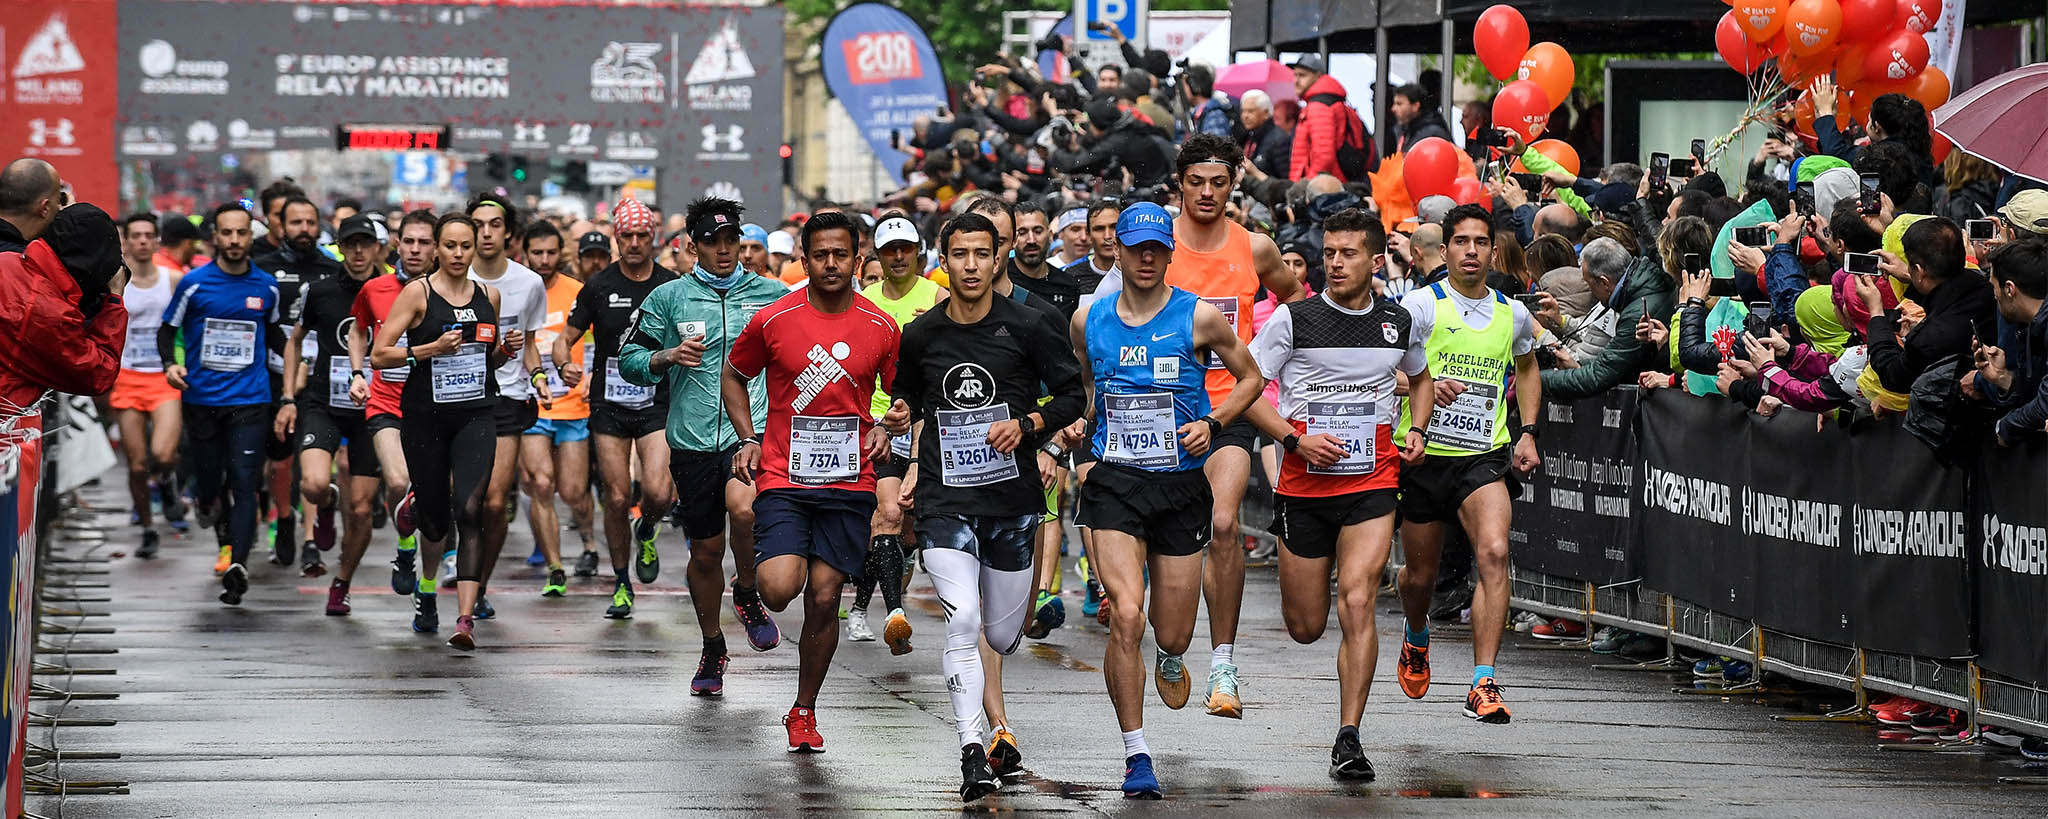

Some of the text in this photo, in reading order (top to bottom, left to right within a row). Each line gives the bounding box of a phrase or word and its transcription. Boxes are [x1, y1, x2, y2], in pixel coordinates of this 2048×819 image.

[1765, 7, 1776, 15] FOR
[1805, 25, 1817, 34] RUN
[176, 60, 230, 79] europ
[302, 54, 377, 74] EUROP
[378, 56, 510, 77] ASSISTANCE
[1898, 57, 1910, 70] RUN
[140, 77, 230, 95] assistance
[276, 74, 511, 98] RELAY MARATHON
[1135, 214, 1164, 225] ITALIA
[1119, 345, 1148, 361] DKR
[1438, 351, 1504, 371] MACELLERIA
[806, 343, 848, 384] SPORT
[1159, 363, 1176, 373] JBL
[445, 372, 477, 386] 3269A
[793, 362, 821, 392] SENZA
[616, 385, 646, 396] 2756A
[790, 371, 831, 414] FRONTIERE
[954, 379, 985, 398] AR
[1306, 383, 1378, 393] almostthere
[1442, 412, 1482, 432] 2456A
[959, 428, 981, 436] RELAY
[1121, 432, 1160, 450] 1479A
[1438, 437, 1487, 449] UNDER ARMOUR
[809, 453, 840, 468] 737A
[956, 446, 999, 466] 3261A
[958, 469, 1012, 483] UNDER ARMOUR
[1688, 477, 1731, 526] ARMOUR
[1752, 491, 1841, 548] UNDER ARMOUR
[1861, 508, 1965, 559] UNDER ARMOUR
